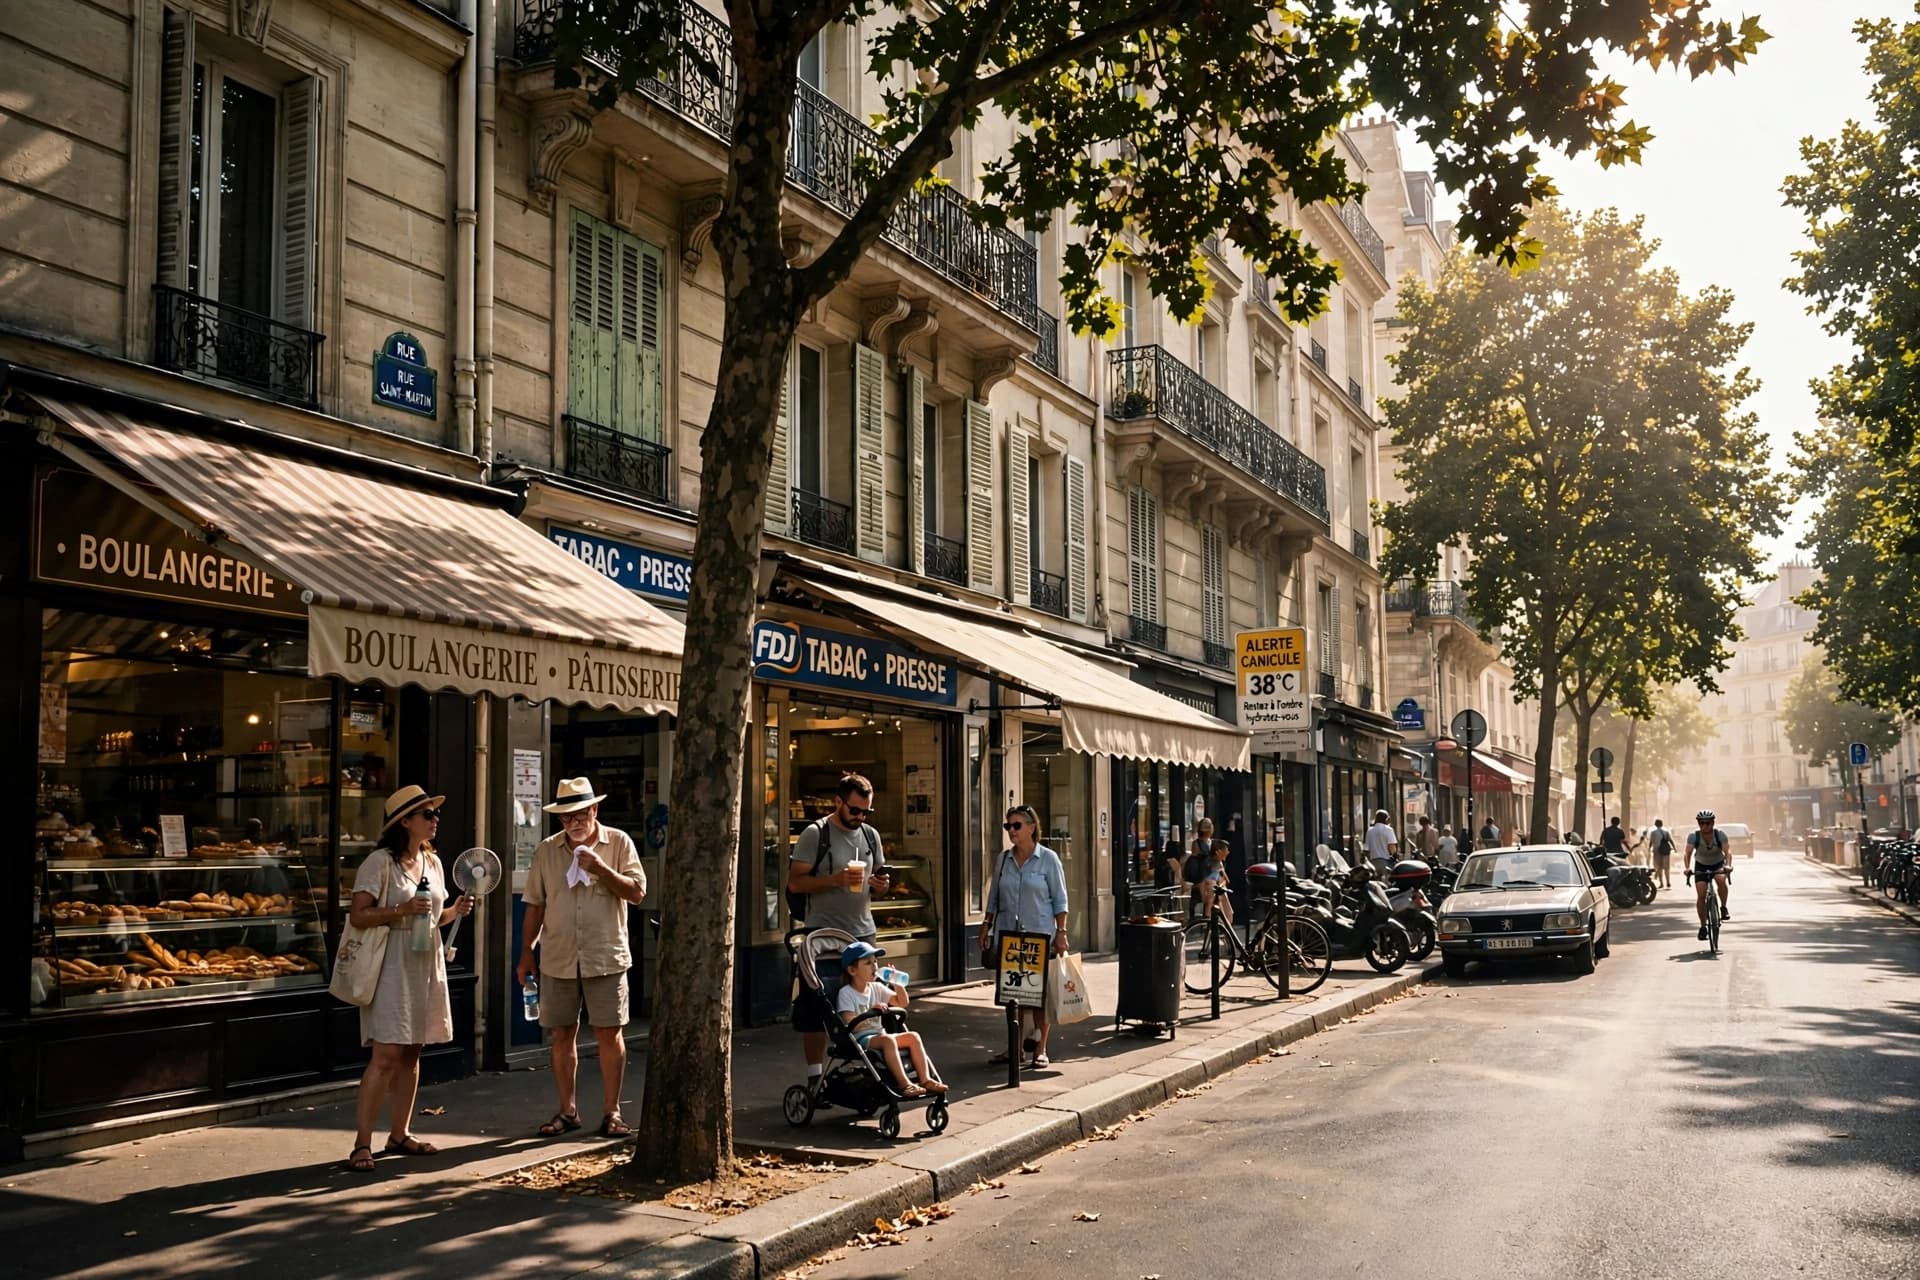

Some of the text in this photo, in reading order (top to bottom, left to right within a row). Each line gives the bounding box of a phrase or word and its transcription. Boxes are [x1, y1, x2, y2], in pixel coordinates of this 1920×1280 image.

[397, 341, 416, 360] RUE
[398, 369, 415, 386] RUE
[79, 533, 275, 598] BOULANGERIE
[344, 627, 538, 686] BOULANGERIE
[755, 629, 797, 663] FDJ
[1246, 637, 1293, 653] ALERTE
[806, 637, 947, 694] TABAC PRESSE
[1241, 652, 1300, 668] CANICULE
[1250, 673, 1294, 696] 38°C
